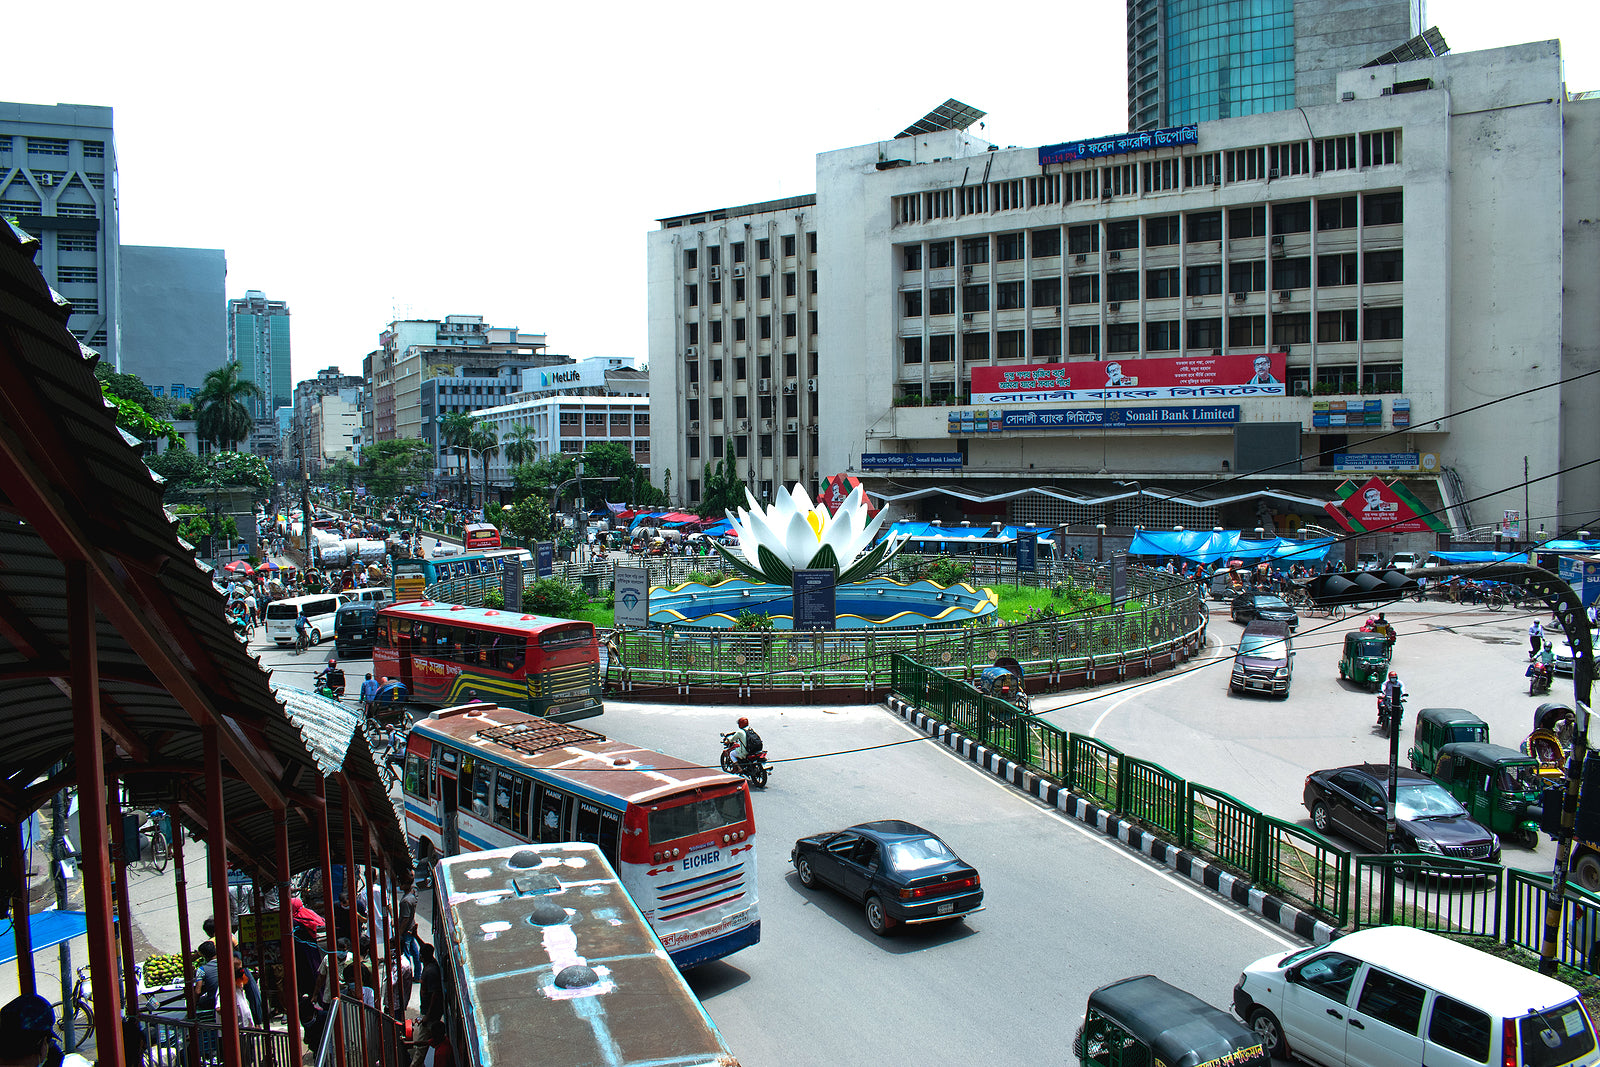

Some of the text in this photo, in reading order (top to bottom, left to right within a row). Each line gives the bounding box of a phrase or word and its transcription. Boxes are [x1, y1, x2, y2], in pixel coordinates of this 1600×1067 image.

[1088, 141, 1115, 154] ফরেন
[1117, 133, 1151, 149] কারেন্সি
[1065, 152, 1076, 161] PM
[552, 370, 580, 383] MetLife
[990, 386, 1285, 402] সোনালী ব্যাংক লিমিটেড
[1006, 412, 1037, 424] সোনালী
[1040, 414, 1064, 424] ব্যাংক
[1066, 410, 1103, 423] লিমিটেড
[1126, 408, 1235, 421] Sonali Bank Limited
[546, 789, 562, 800] MANIK
[581, 803, 599, 815] MANIK
[683, 850, 720, 870] EICHER
